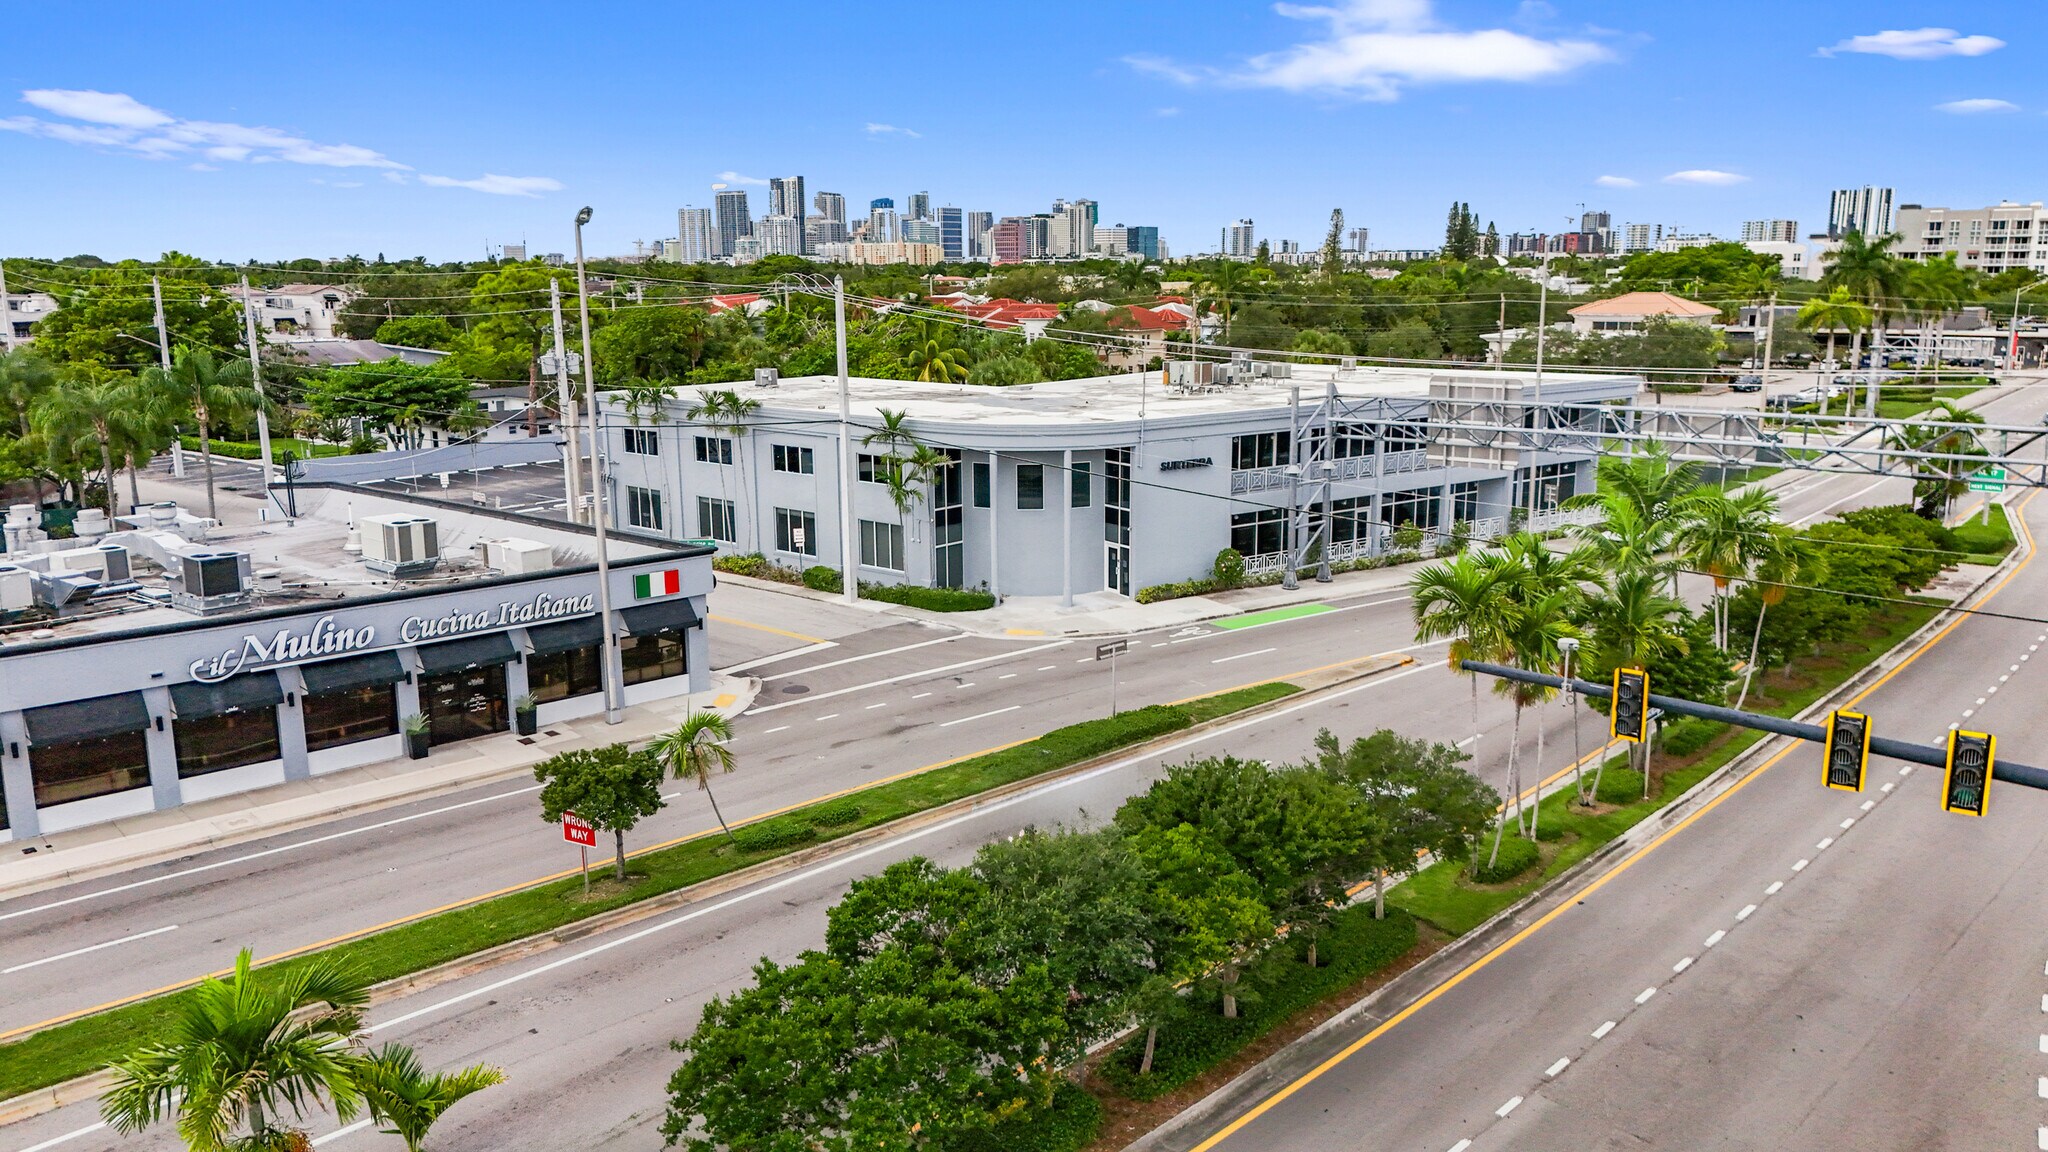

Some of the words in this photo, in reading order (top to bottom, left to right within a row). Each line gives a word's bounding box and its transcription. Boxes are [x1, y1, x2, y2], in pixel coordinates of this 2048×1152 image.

[240, 615, 375, 665] Mulino
[400, 608, 490, 643] Cucina
[495, 592, 594, 626] Italiana
[564, 813, 593, 830] WRONG
[570, 828, 588, 841] WAY
